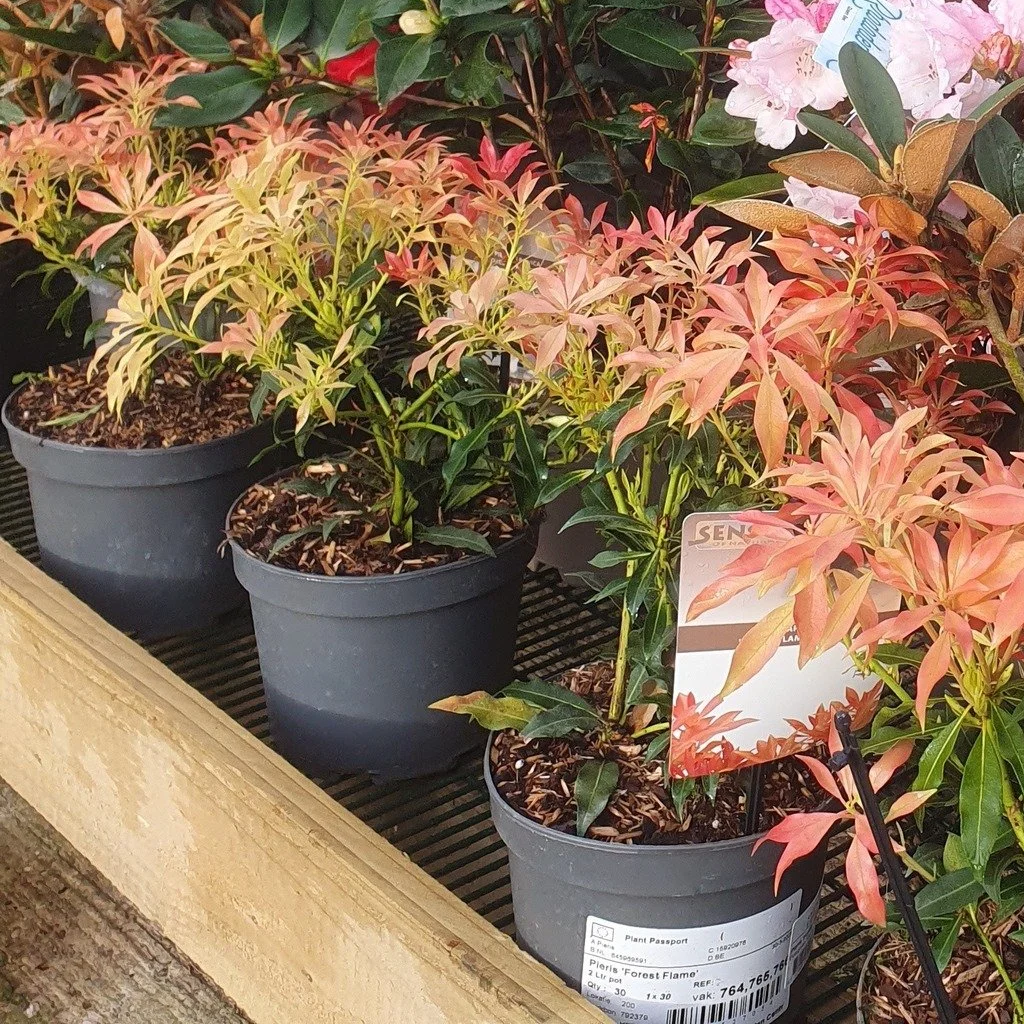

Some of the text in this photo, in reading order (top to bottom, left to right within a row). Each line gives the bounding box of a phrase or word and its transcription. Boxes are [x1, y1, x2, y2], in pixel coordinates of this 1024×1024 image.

[625, 934, 688, 946] Plant Passport
[589, 958, 699, 980] Pieris 'Forest Flame'
[614, 987, 627, 997] 30
[659, 993, 672, 1001] 30
[692, 991, 715, 1003] vak:
[621, 1000, 636, 1009] 200
